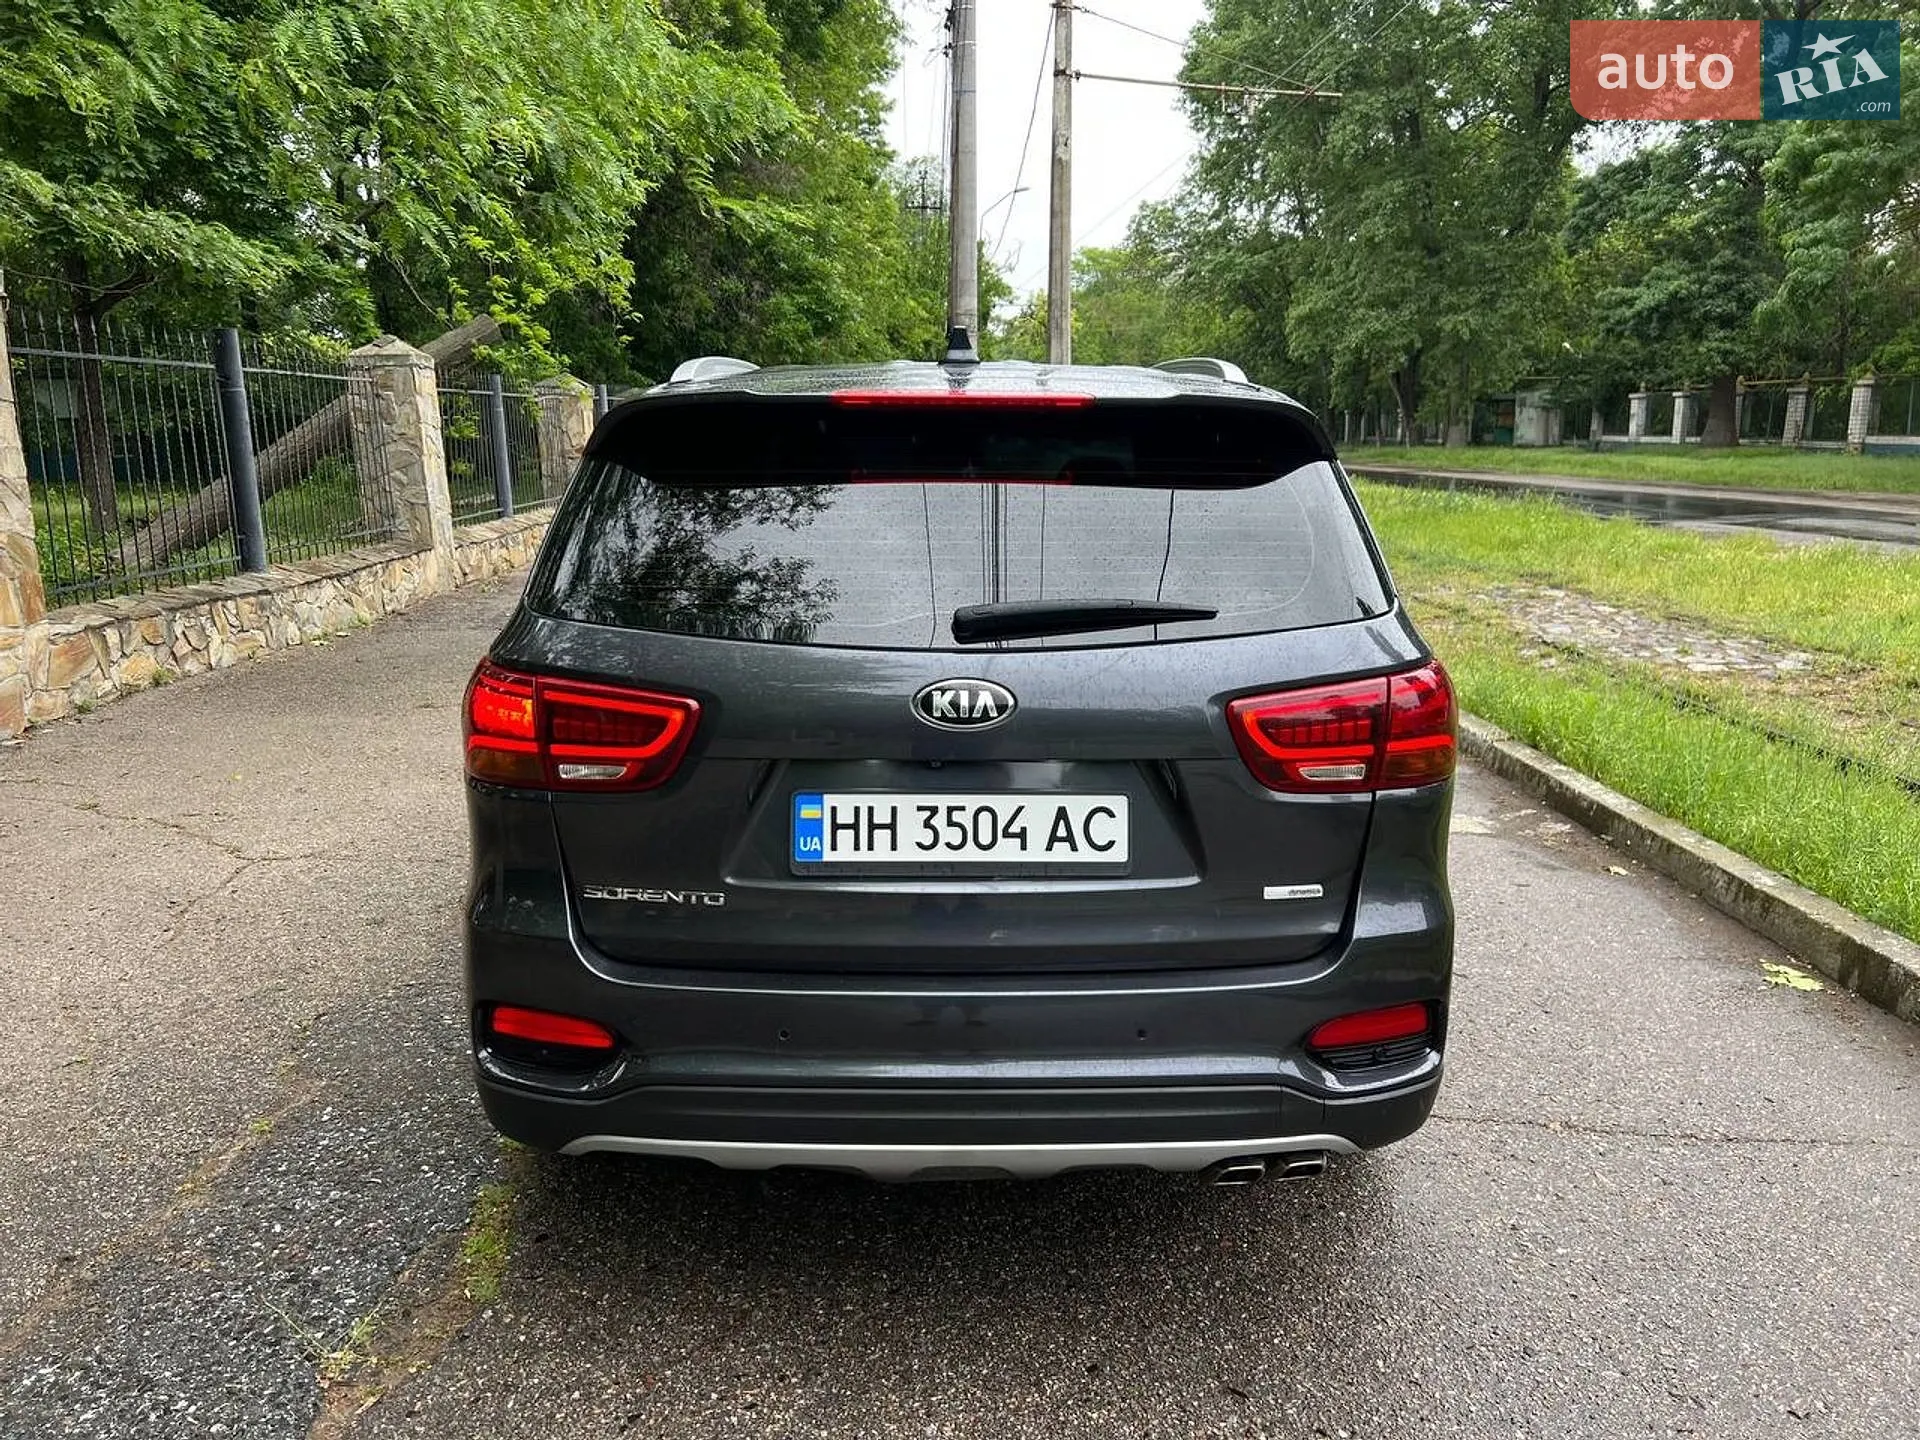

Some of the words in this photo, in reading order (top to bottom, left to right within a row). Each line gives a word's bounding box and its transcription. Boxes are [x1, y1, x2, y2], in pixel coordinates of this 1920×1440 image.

[931, 689, 999, 718] KIA
[830, 805, 898, 852] HH
[915, 805, 1028, 852] 3504
[1045, 805, 1117, 852] AC
[800, 836, 822, 852] UA
[583, 885, 726, 906] SORENTO
